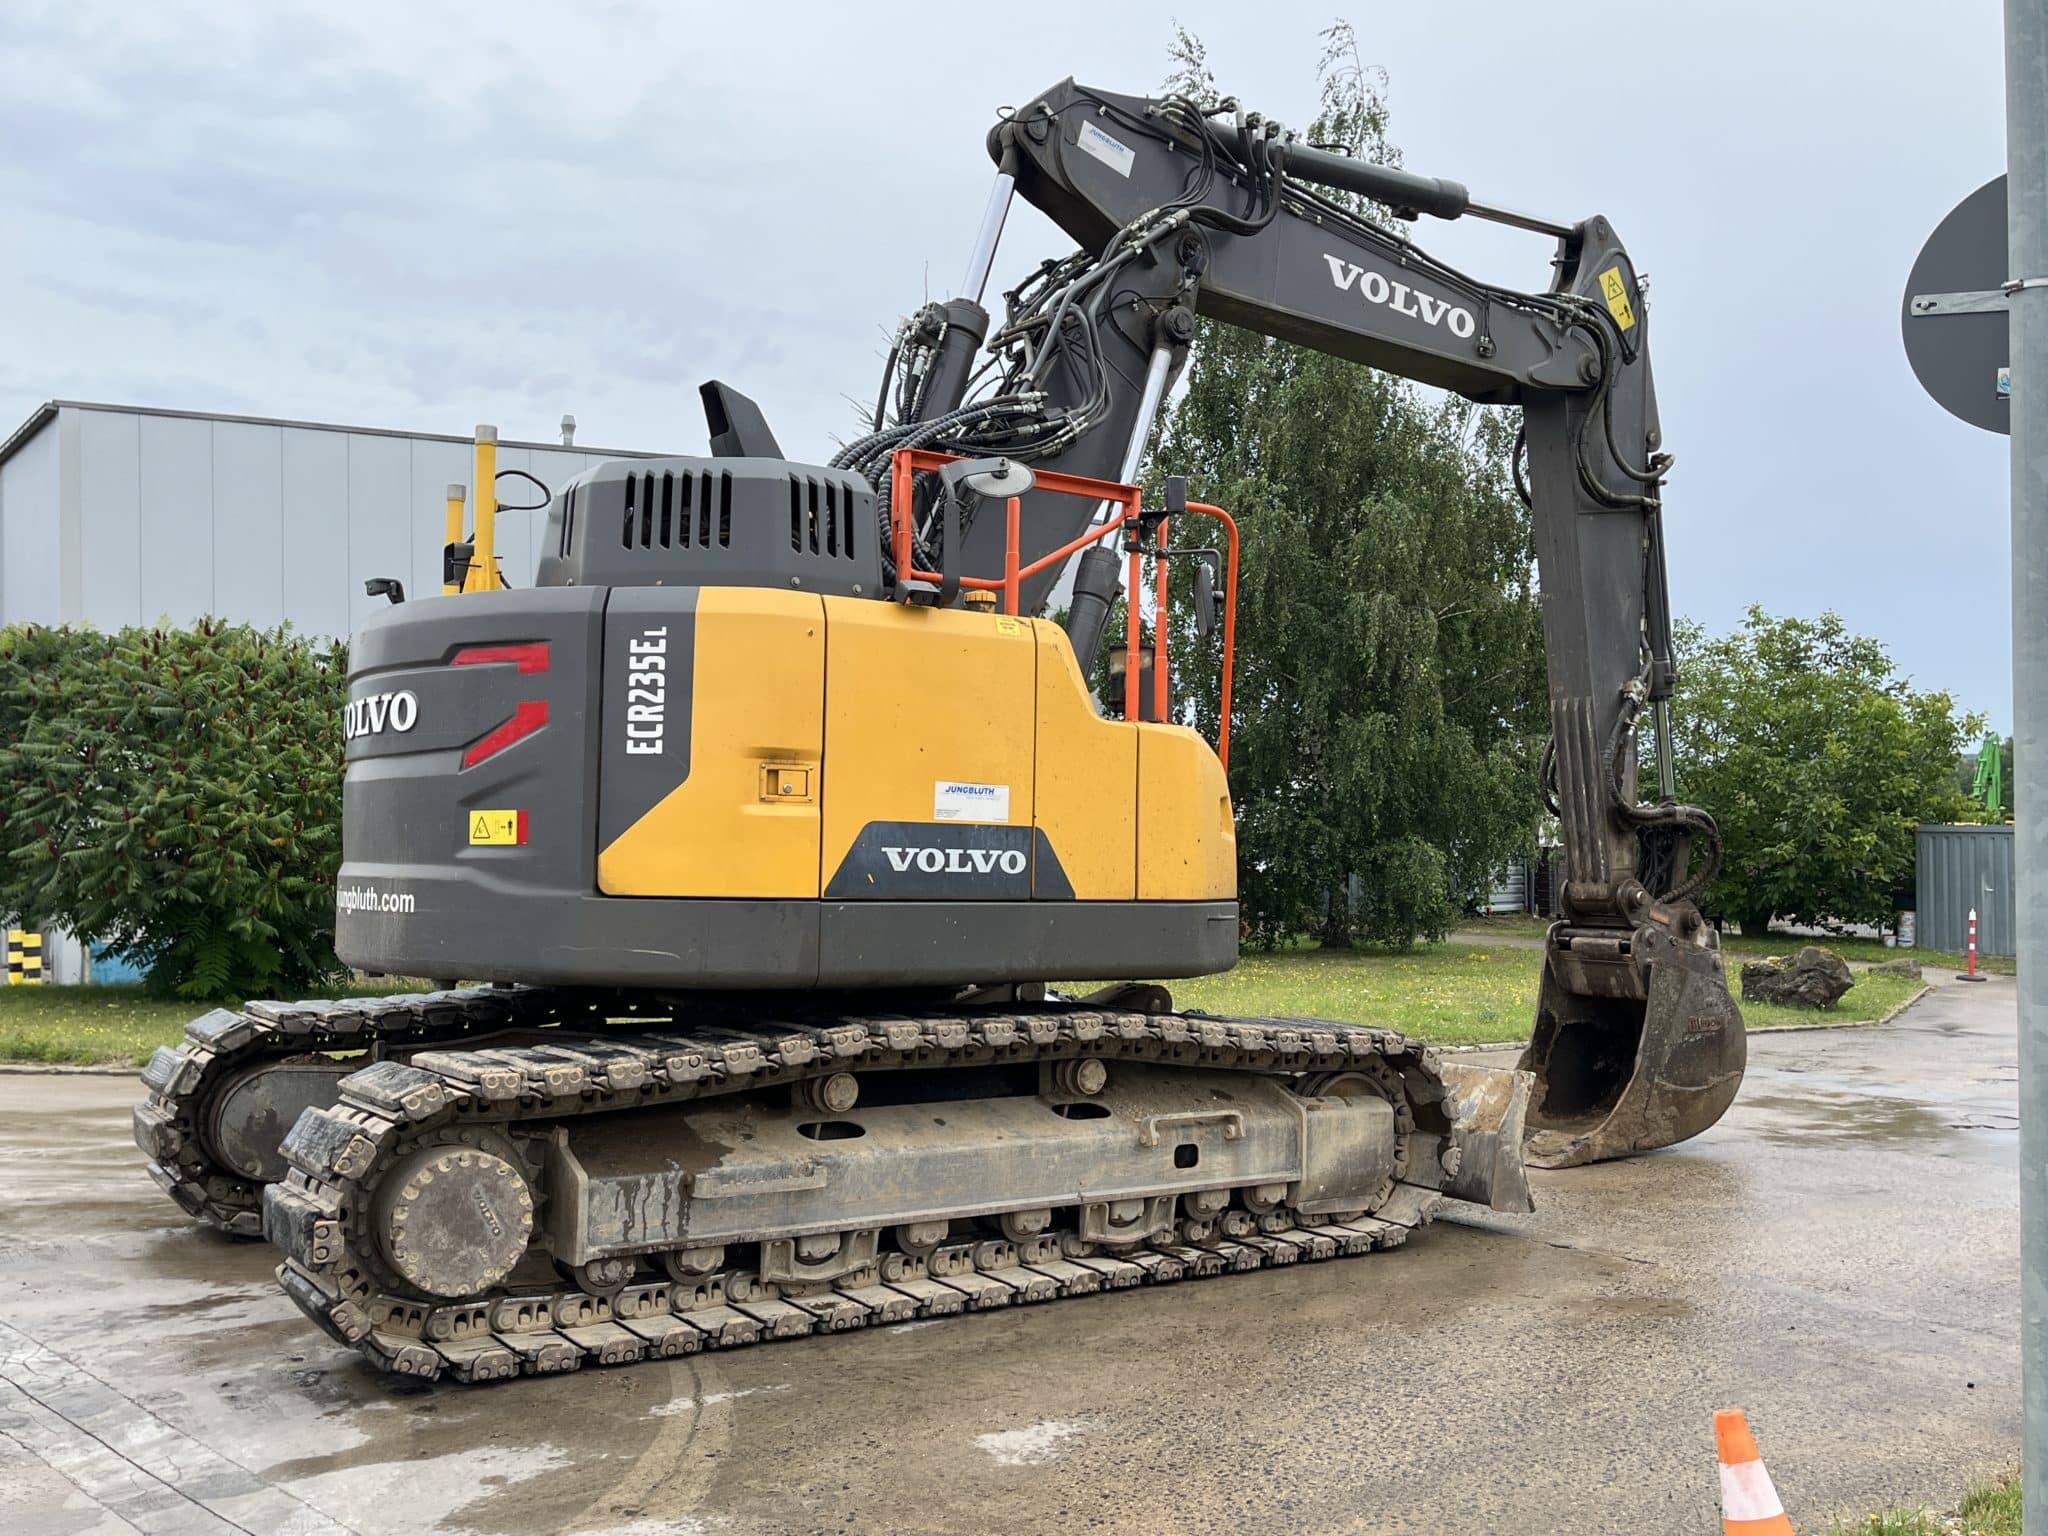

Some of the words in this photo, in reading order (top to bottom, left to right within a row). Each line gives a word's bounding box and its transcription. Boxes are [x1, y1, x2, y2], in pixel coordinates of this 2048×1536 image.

[1323, 253, 1475, 338] VOLVO
[626, 626, 667, 754] ECR235EL
[343, 692, 417, 741] OLVO
[945, 785, 995, 796] JUNGBLUTH
[881, 847, 1026, 874] VOLVO
